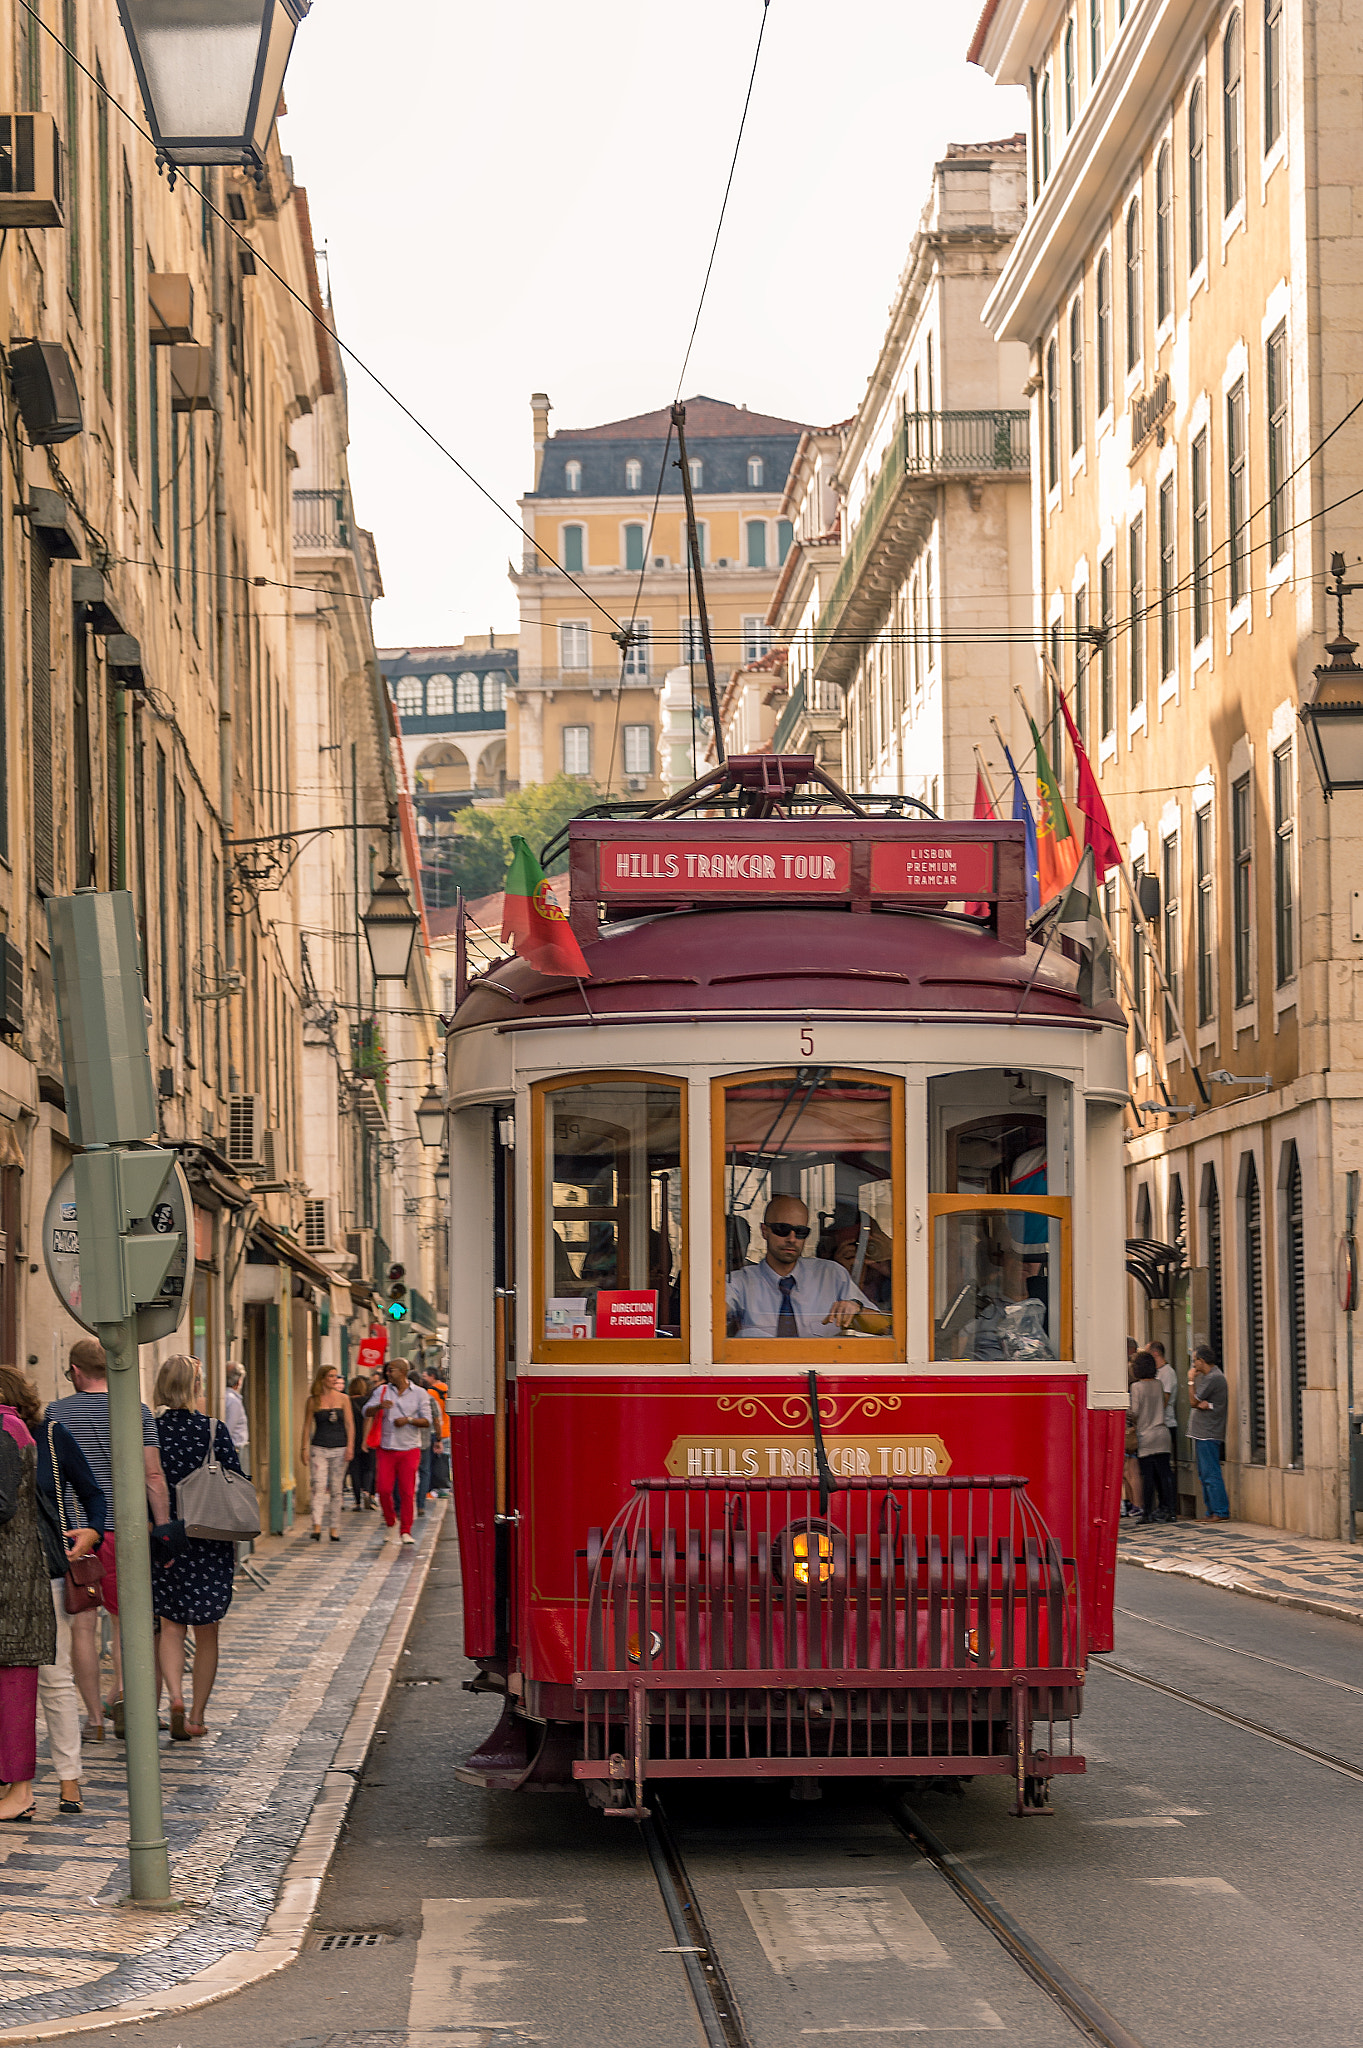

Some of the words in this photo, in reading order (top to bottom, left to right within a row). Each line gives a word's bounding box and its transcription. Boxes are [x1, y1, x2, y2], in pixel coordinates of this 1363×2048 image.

[910, 848, 952, 859] LISBON
[616, 853, 680, 878] HILLS
[684, 853, 776, 879] TRAMCAR
[780, 854, 837, 880] TOUR
[906, 862, 957, 872] PREMIUM
[906, 875, 957, 885] TRAMCAR
[800, 1028, 814, 1057] 5
[611, 1303, 653, 1313] DIRECTION
[687, 1447, 759, 1476] HILLS
[876, 1446, 939, 1475] TOUR
